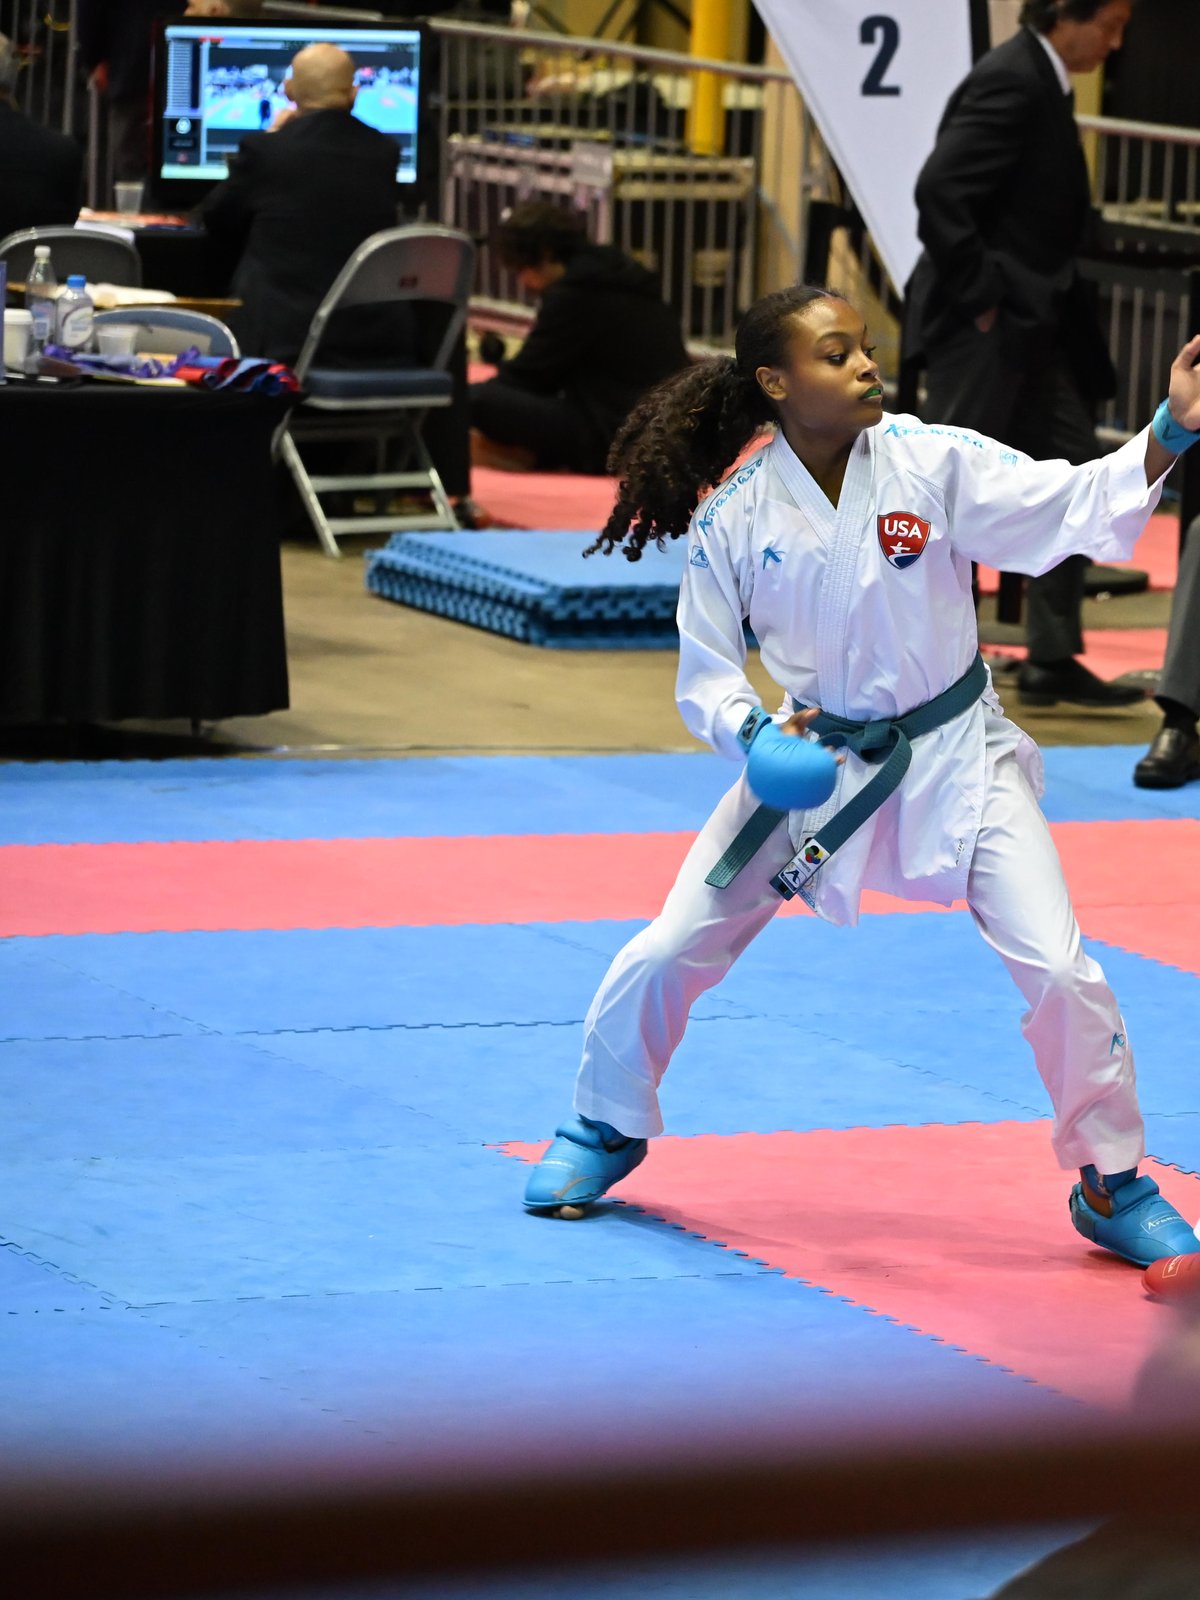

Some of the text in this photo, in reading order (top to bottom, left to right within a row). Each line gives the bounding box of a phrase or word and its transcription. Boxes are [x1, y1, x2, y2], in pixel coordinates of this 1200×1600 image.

[859, 14, 901, 97] 2
[884, 423, 984, 449] Arawaza
[884, 518, 922, 539] USA
